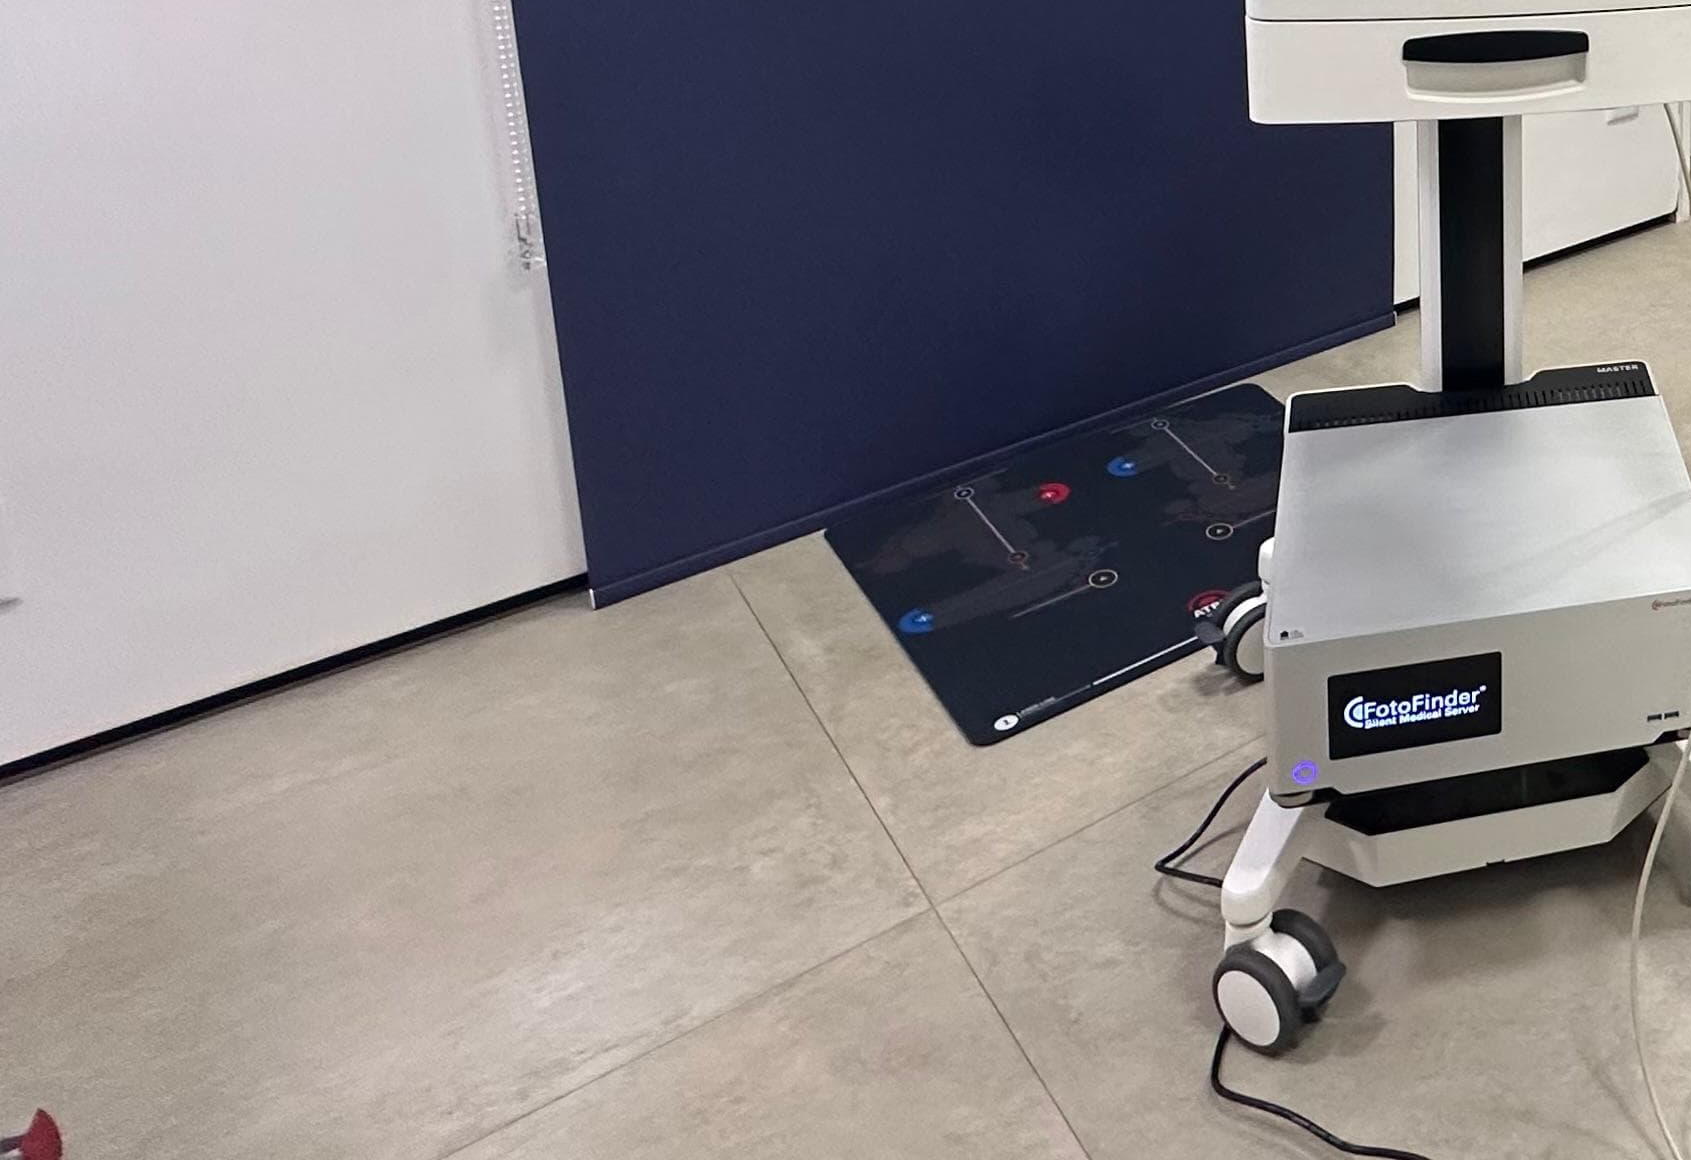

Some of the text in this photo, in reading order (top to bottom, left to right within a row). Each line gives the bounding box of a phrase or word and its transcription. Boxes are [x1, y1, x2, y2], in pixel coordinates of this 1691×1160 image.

[1597, 364, 1638, 373] MASTER
[1363, 689, 1482, 719] FotoFinder
[1364, 703, 1480, 729] Silent Medical Server
